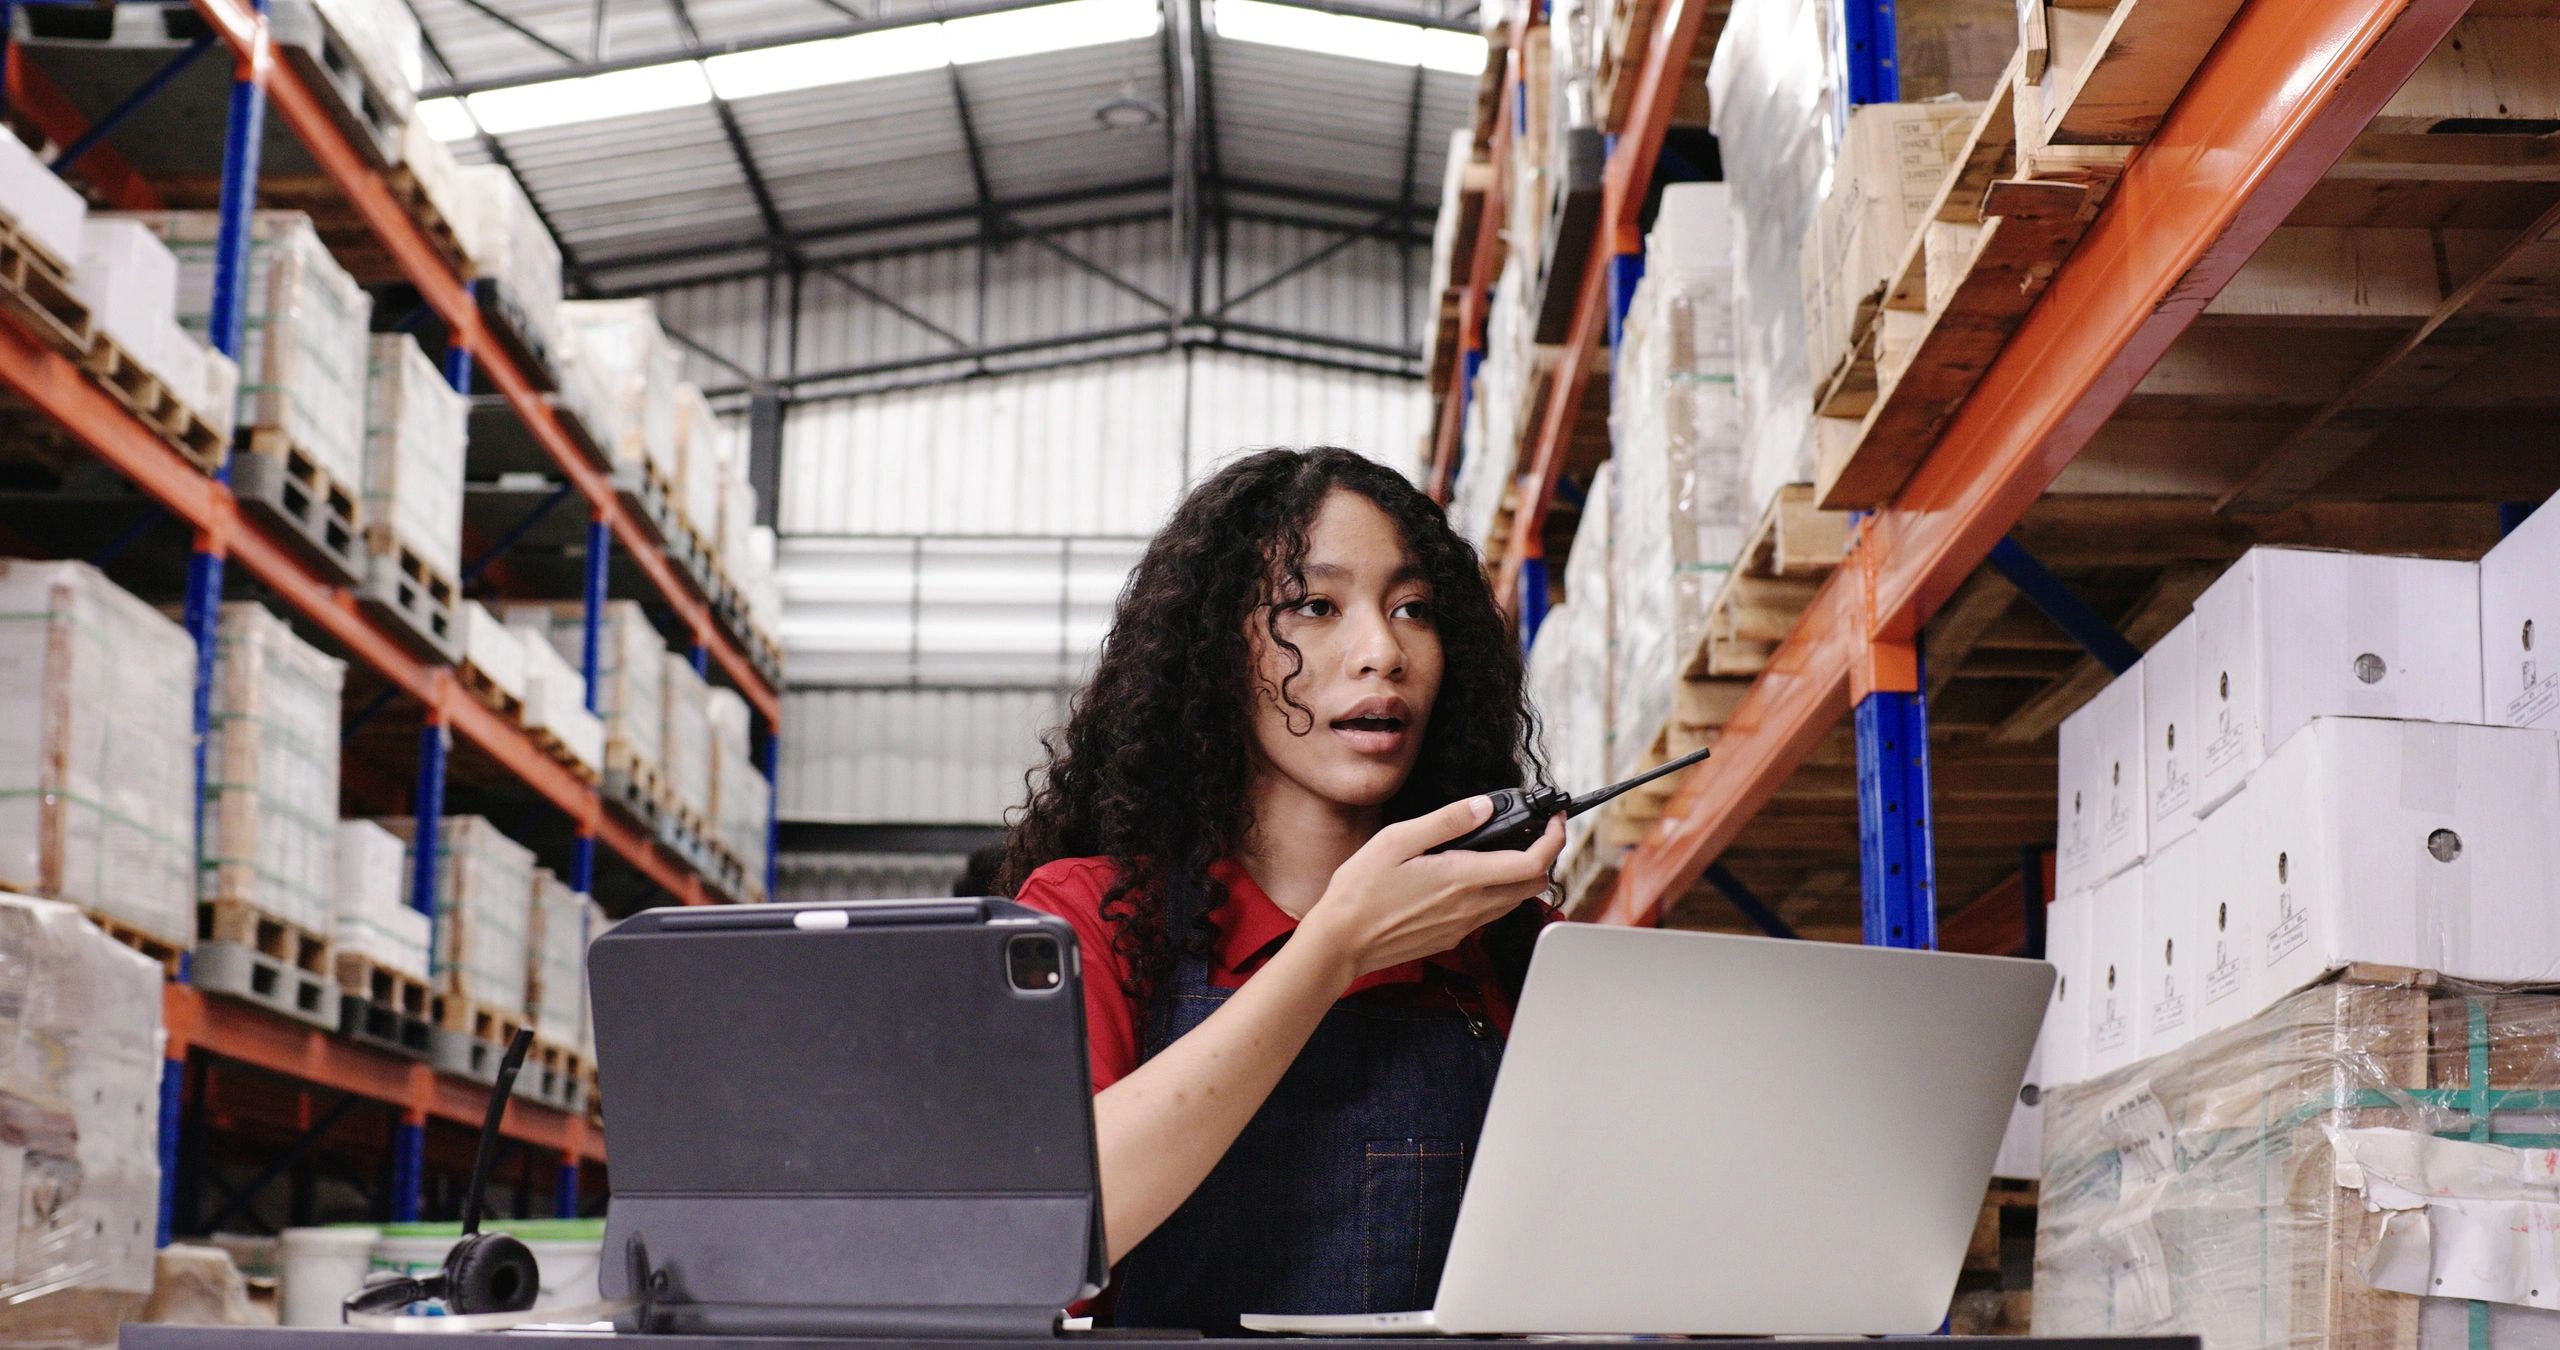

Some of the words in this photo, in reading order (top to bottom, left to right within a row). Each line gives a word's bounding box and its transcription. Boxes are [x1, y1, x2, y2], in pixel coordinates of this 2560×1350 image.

[1899, 124, 1920, 134] ITEM
[1900, 138, 1931, 148] SHADE
[1903, 154, 1921, 164] SIZE
[1905, 168, 1942, 179] QUANTITY
